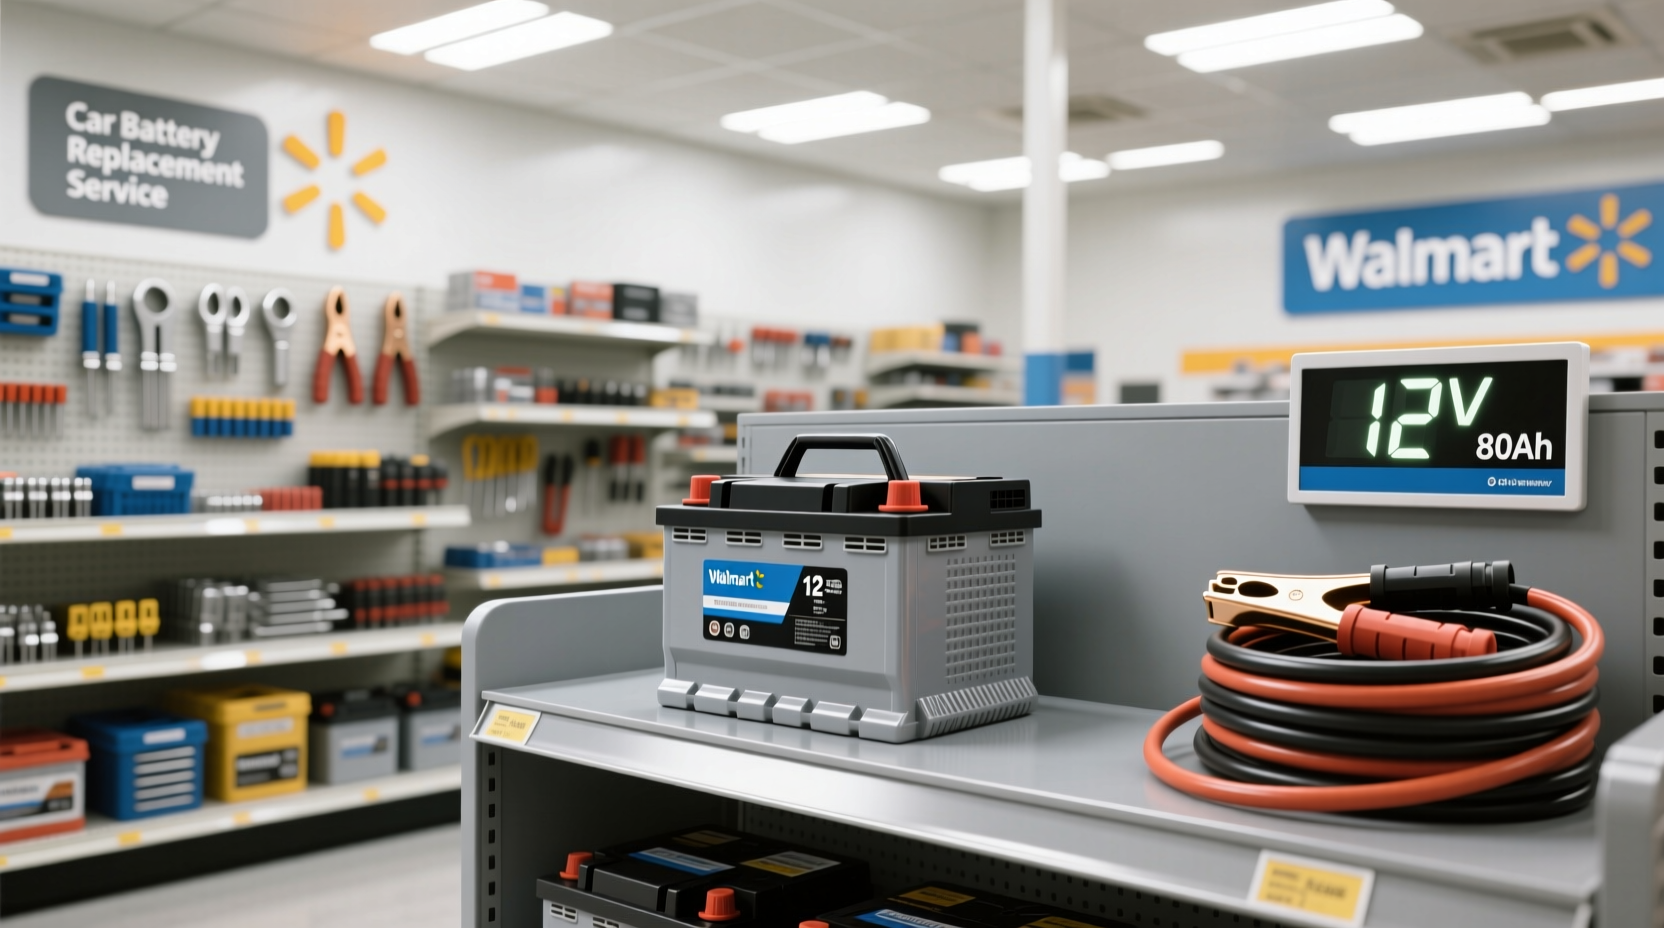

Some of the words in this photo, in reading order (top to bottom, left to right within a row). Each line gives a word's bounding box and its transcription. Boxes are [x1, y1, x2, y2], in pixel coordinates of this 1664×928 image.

[65, 101, 116, 136] Car
[120, 110, 220, 159] Battery
[66, 135, 245, 189] Replacement
[66, 169, 169, 209] Service
[1303, 216, 1560, 292] Walmart
[1475, 431, 1553, 461] 80Ah
[802, 574, 824, 597] 12
